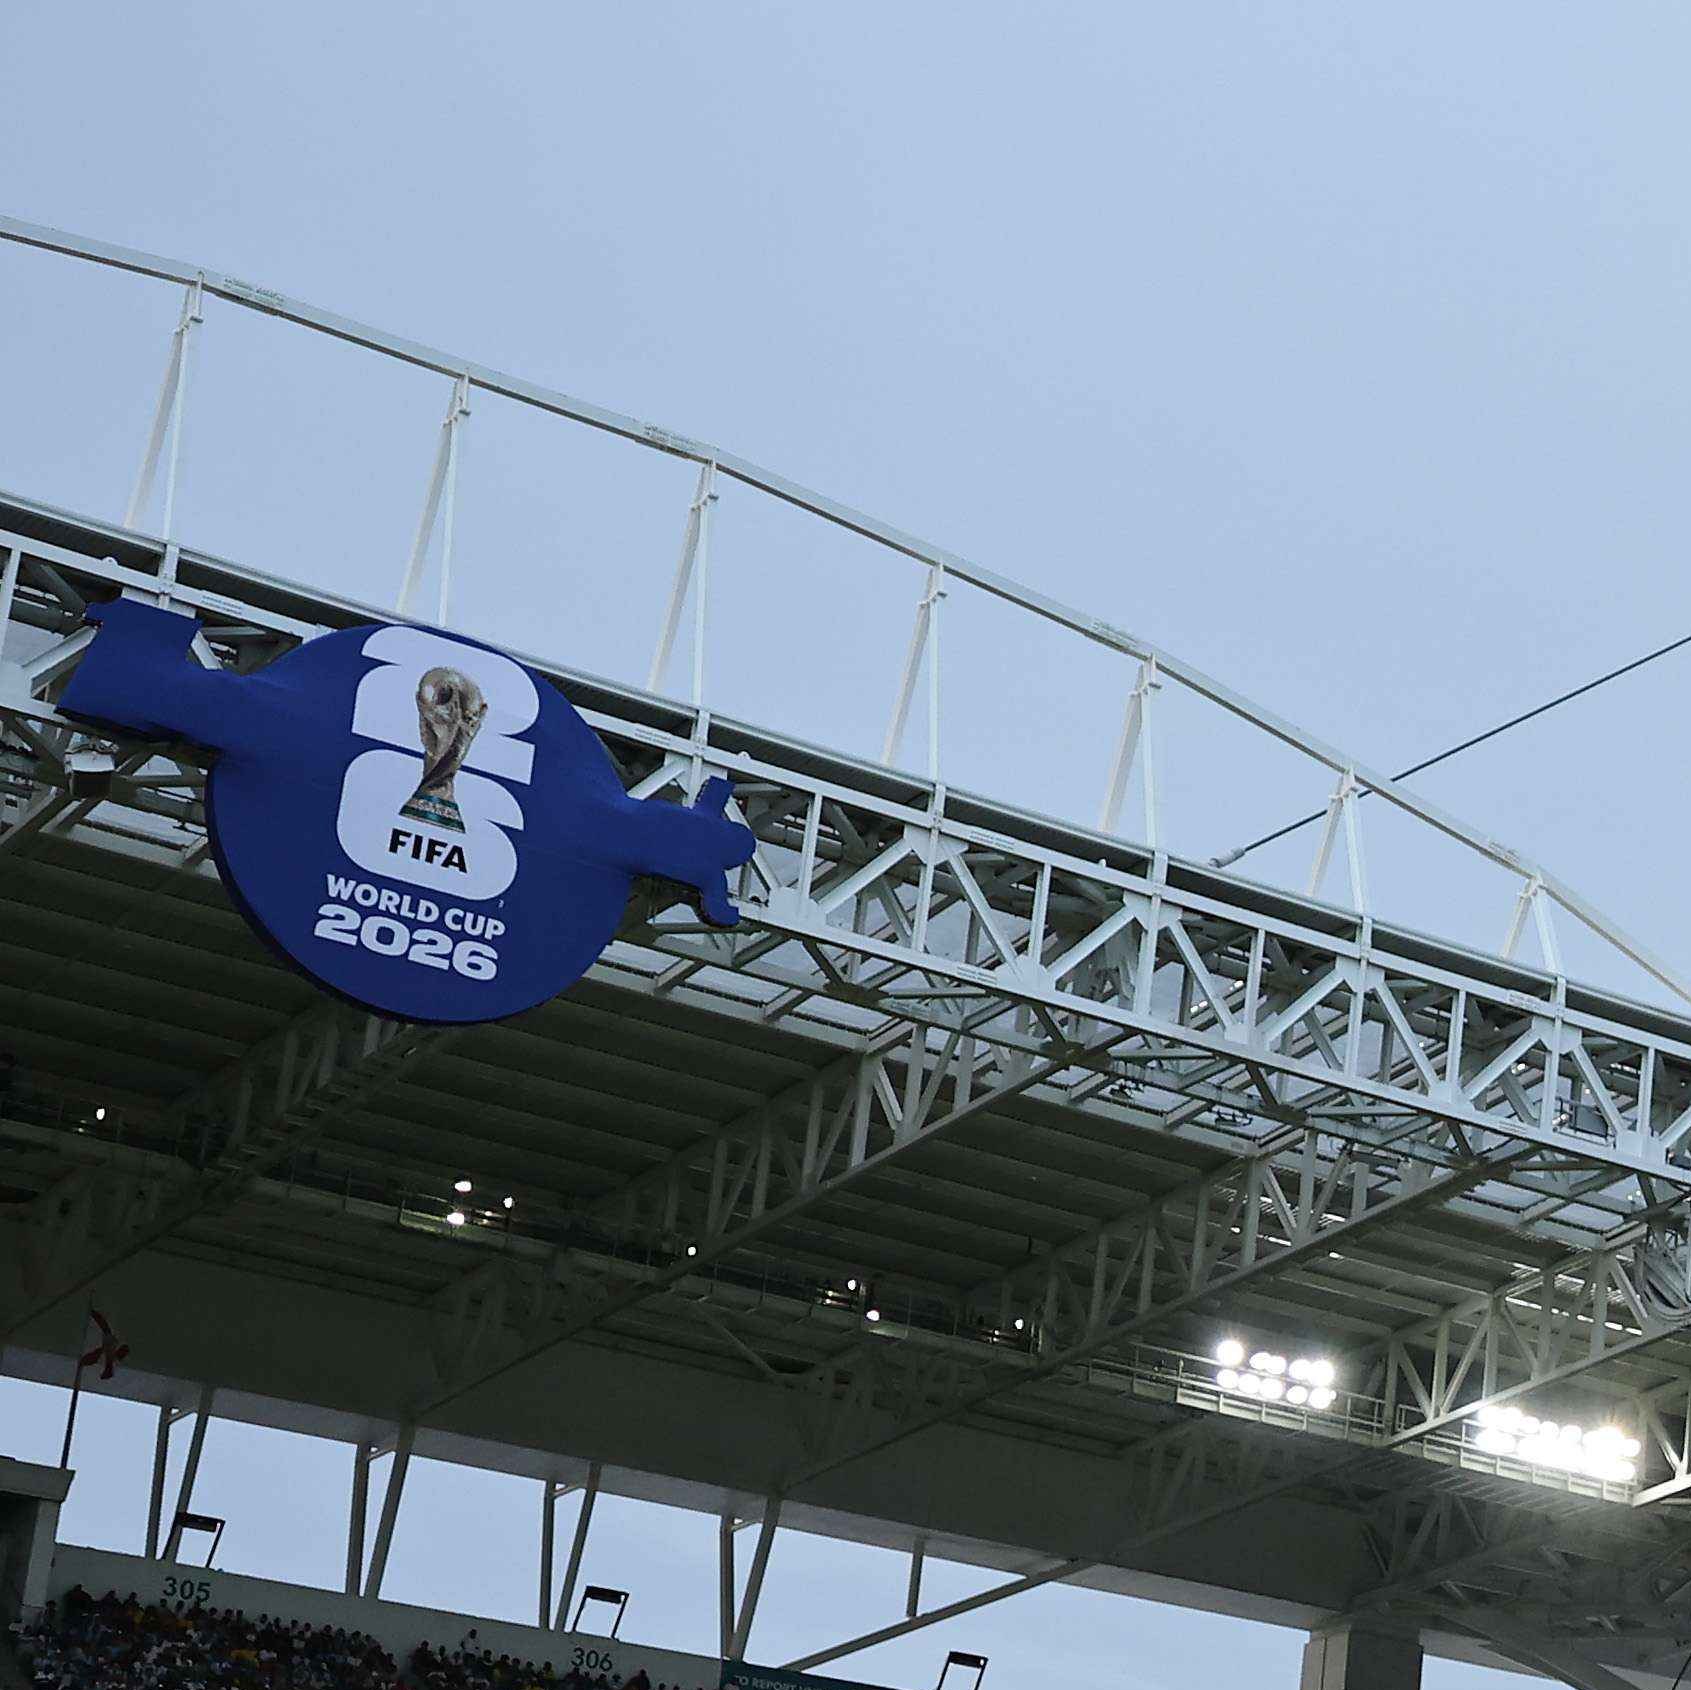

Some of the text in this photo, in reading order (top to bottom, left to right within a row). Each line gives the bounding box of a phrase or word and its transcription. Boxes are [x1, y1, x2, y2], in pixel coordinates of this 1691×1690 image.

[389, 827, 468, 873] FIFA
[326, 873, 507, 941] WORLD CUP
[314, 903, 500, 981] 2026
[163, 1576, 211, 1602] 305
[571, 1647, 613, 1672] 306
